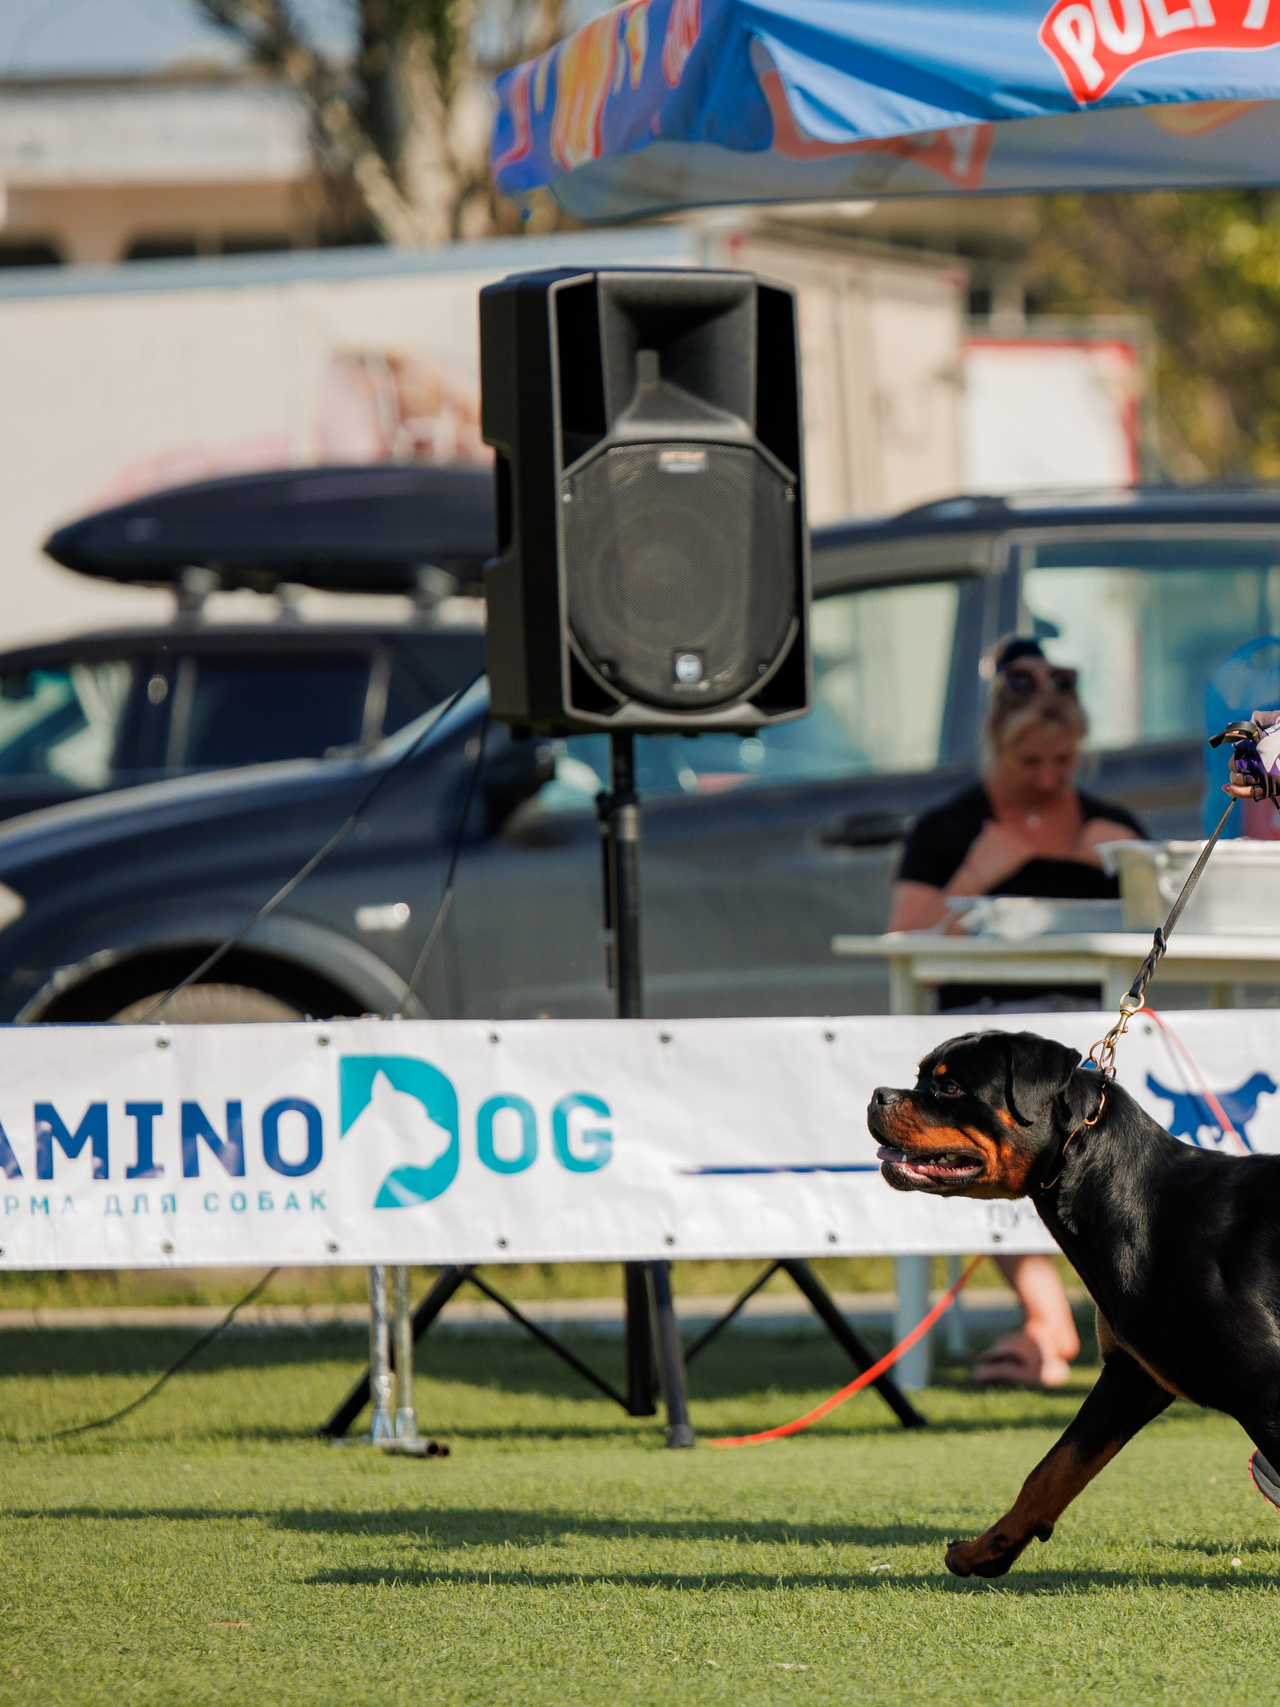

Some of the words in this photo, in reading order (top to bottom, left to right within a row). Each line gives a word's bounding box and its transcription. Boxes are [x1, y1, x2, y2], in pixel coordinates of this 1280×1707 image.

[1052, 0, 1271, 91] PUL
[104, 1193, 177, 1217] ДЛЯ
[204, 1190, 327, 1214] СОБАК
